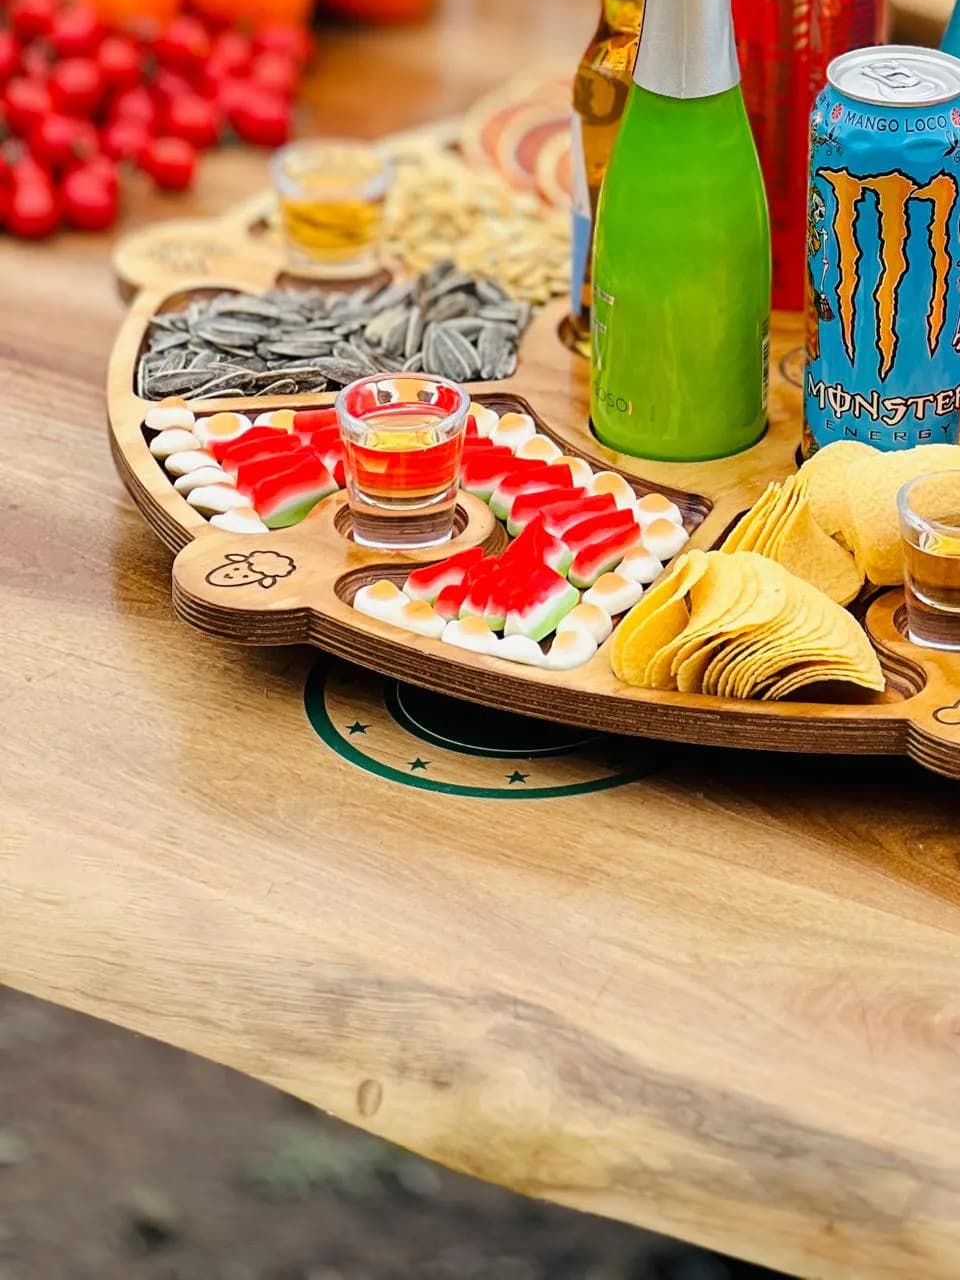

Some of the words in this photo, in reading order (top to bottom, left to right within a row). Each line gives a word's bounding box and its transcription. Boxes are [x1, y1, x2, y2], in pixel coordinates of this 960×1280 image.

[844, 111, 900, 132] MANGO
[905, 115, 947, 133] LOCO
[825, 419, 952, 441] ENERGY
